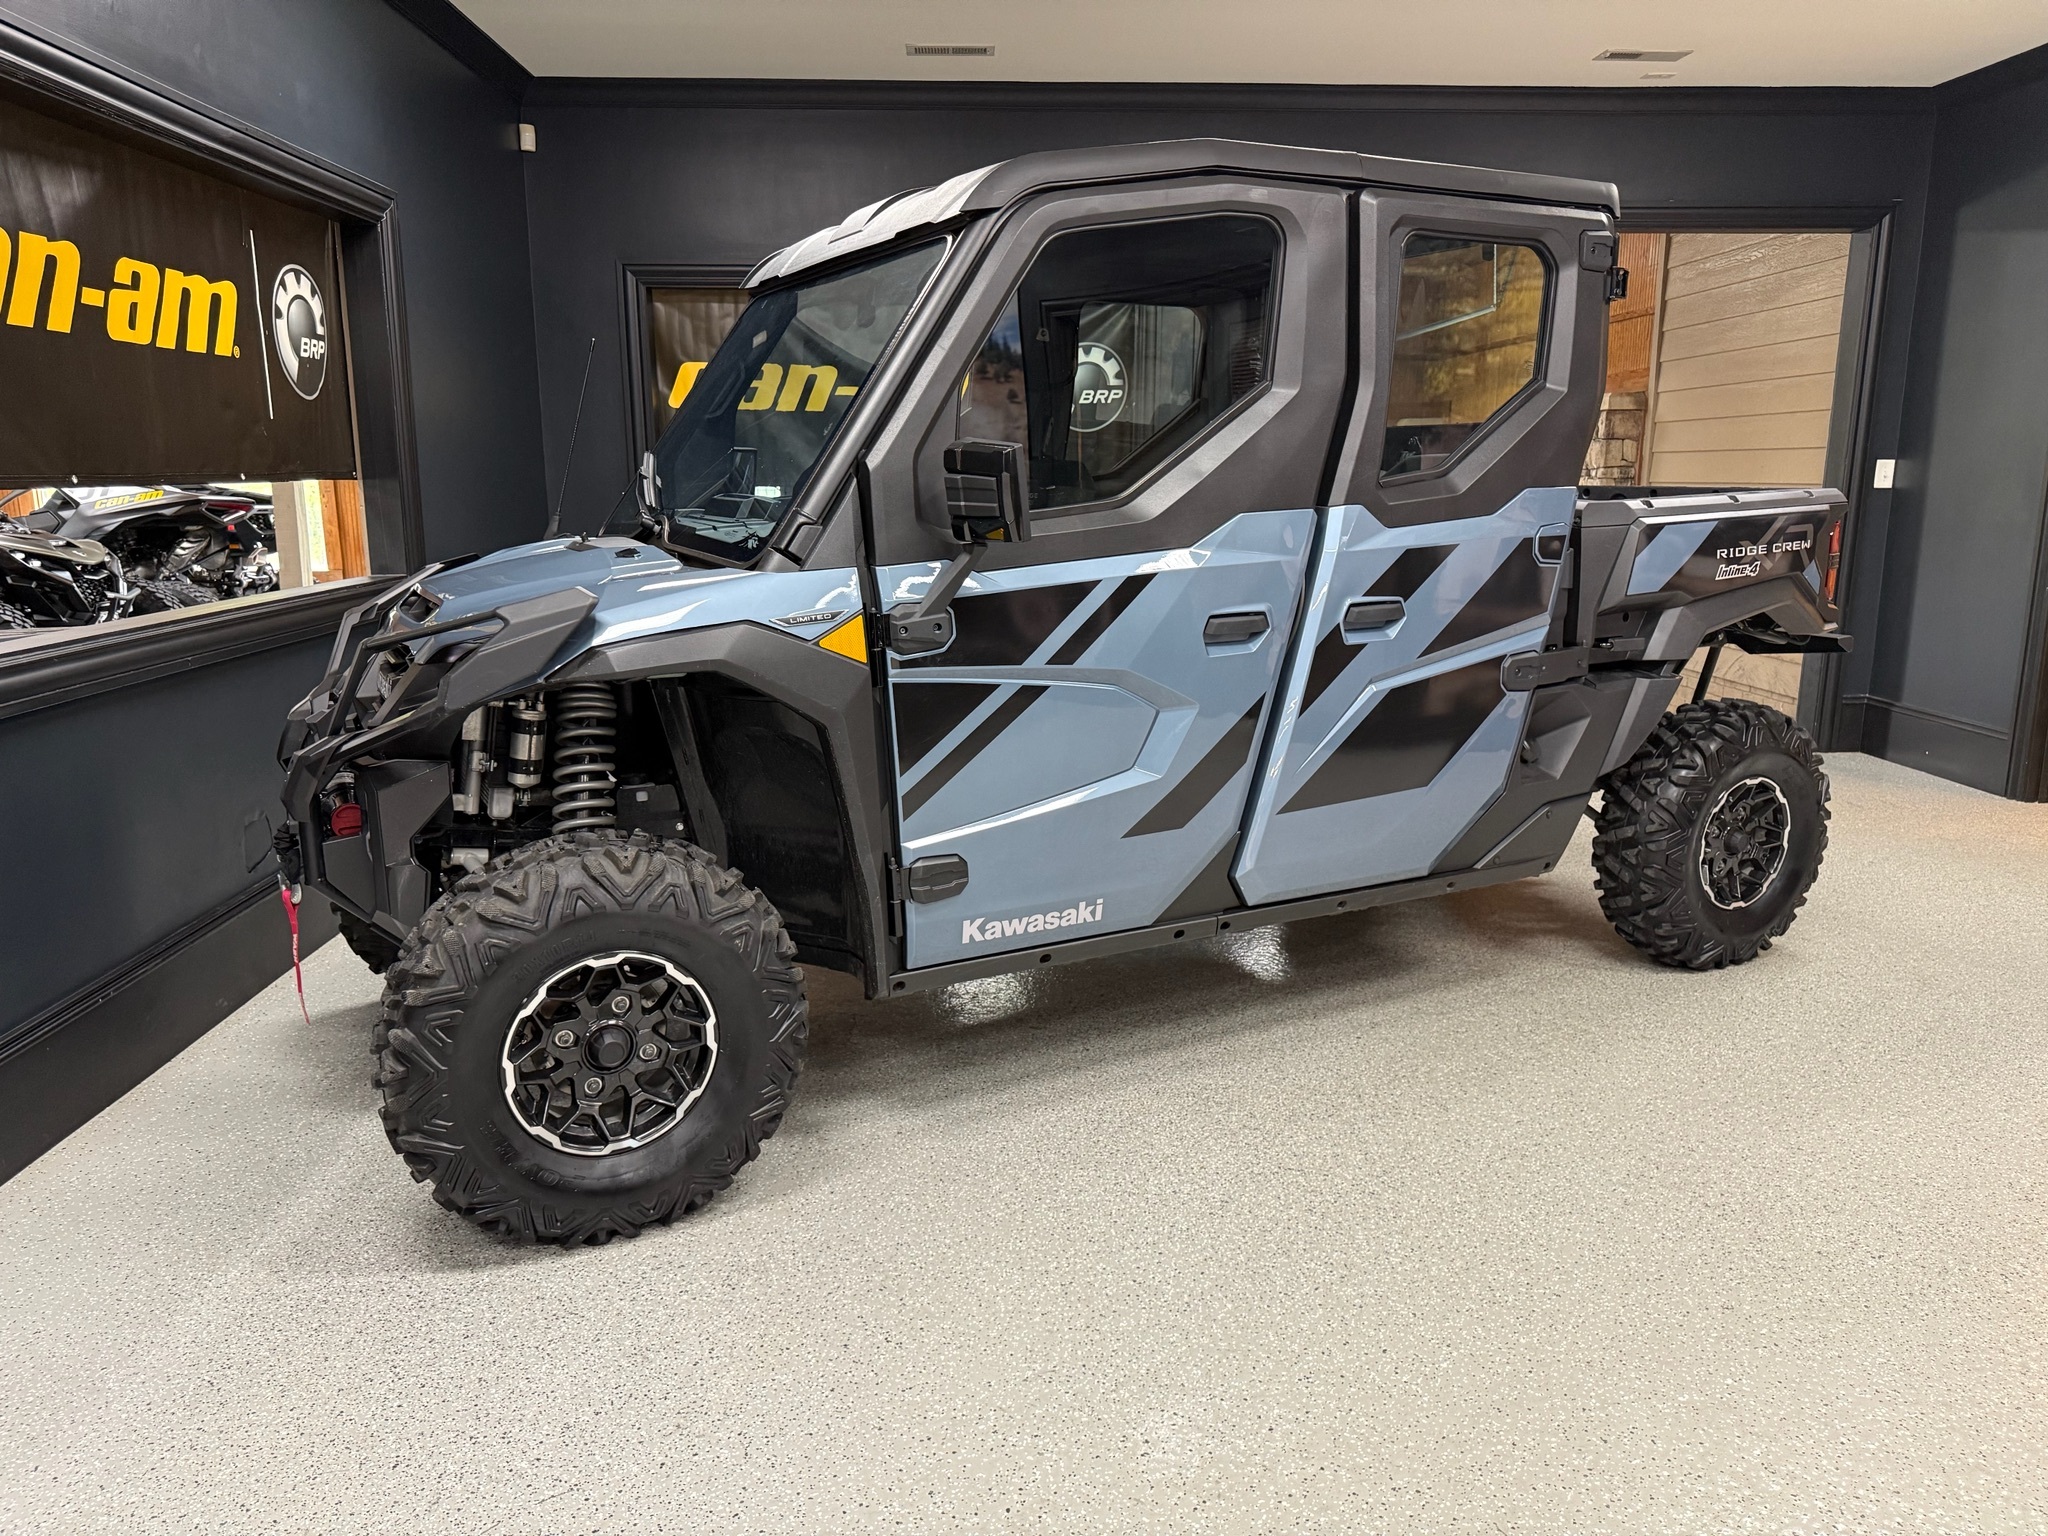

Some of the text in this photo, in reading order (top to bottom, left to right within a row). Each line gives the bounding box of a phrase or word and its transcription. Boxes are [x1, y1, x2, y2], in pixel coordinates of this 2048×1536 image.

[301, 336, 325, 360] BRP
[1078, 389, 1124, 404] BRP
[94, 489, 164, 510] can-am
[1716, 539, 1811, 560] RIDGE CREW
[789, 613, 832, 624] LIMITED
[961, 898, 1104, 944] Kawasaki
